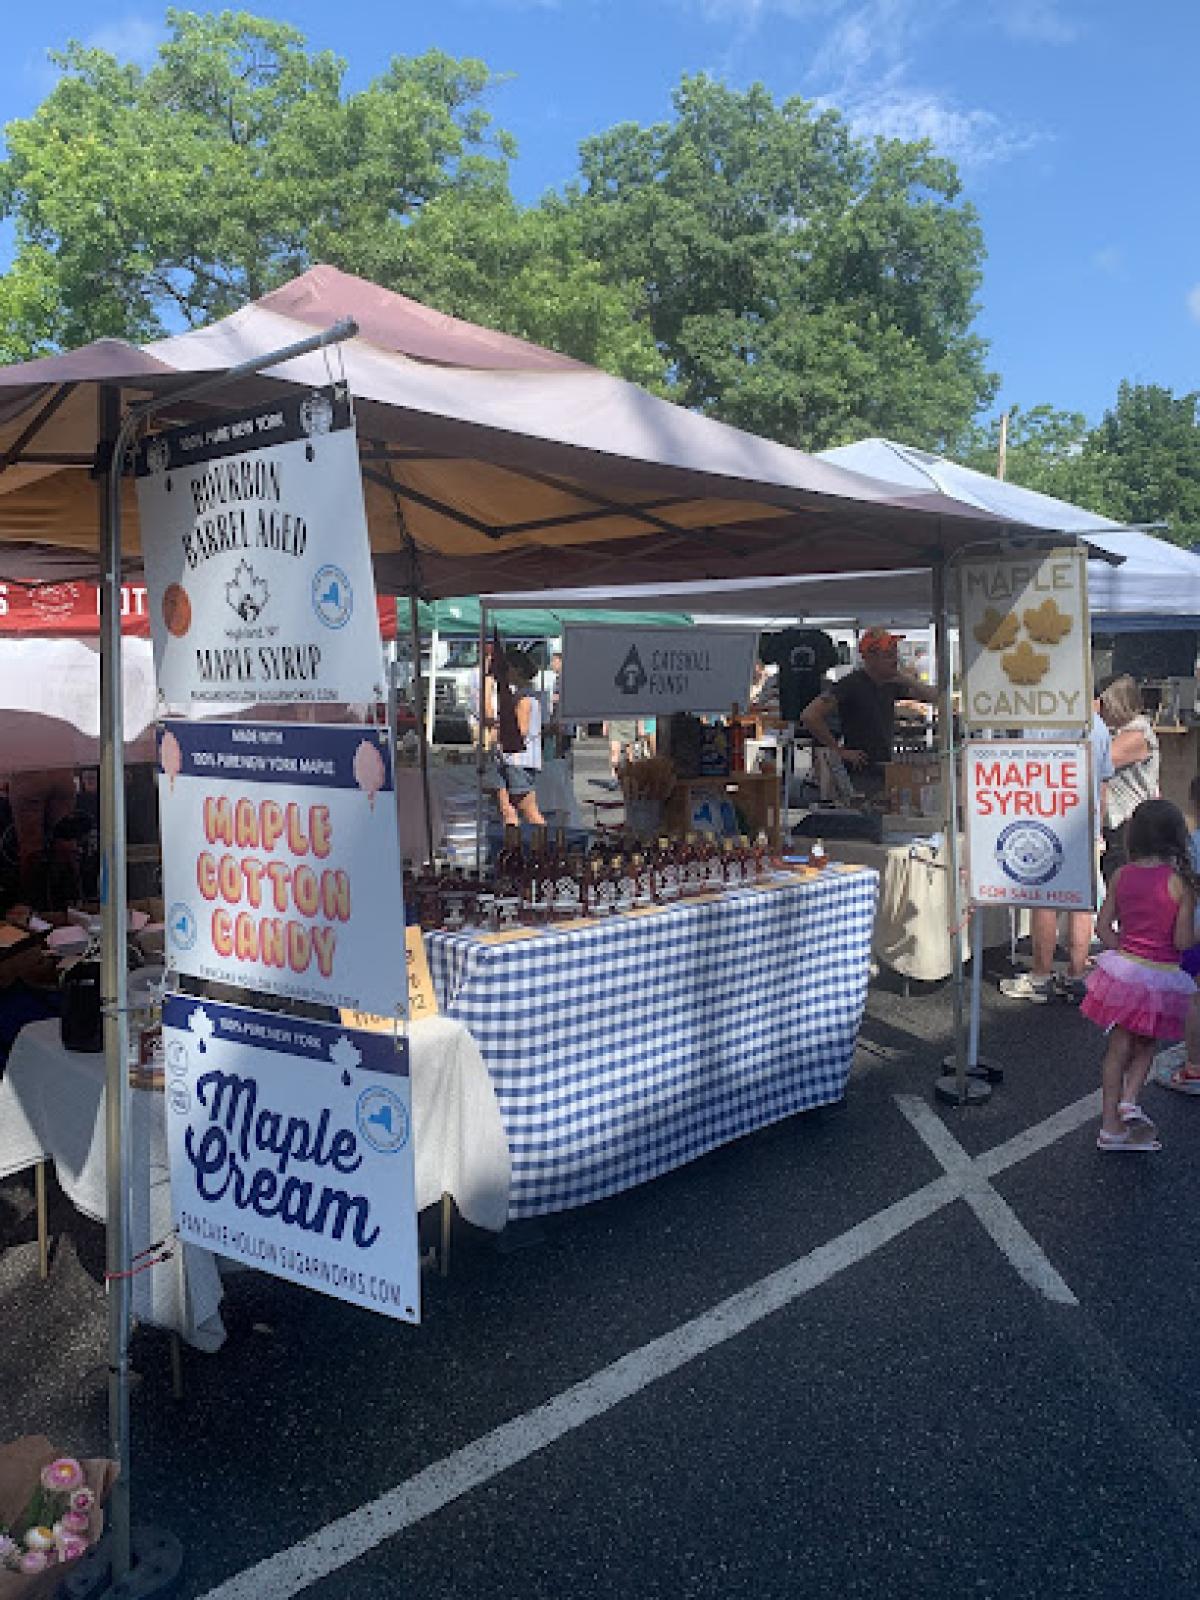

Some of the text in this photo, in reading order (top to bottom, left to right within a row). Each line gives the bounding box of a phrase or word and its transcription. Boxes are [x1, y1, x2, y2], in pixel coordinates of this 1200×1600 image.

[190, 459, 282, 515] BOURBON
[182, 509, 307, 570] BARREL AGED
[967, 563, 1073, 597] MAPLE
[196, 643, 322, 683] MAPLE SYRUP
[972, 690, 1080, 717] CANDY
[975, 761, 1077, 789] MAPLE
[203, 796, 333, 859] MAPLE
[976, 790, 1080, 818] SYRUP
[196, 850, 351, 922] COTTON
[979, 885, 1083, 903] FOR SALE HERE
[211, 908, 337, 978] CANDY
[196, 1070, 363, 1174] Maple
[185, 1125, 381, 1248] Cream
